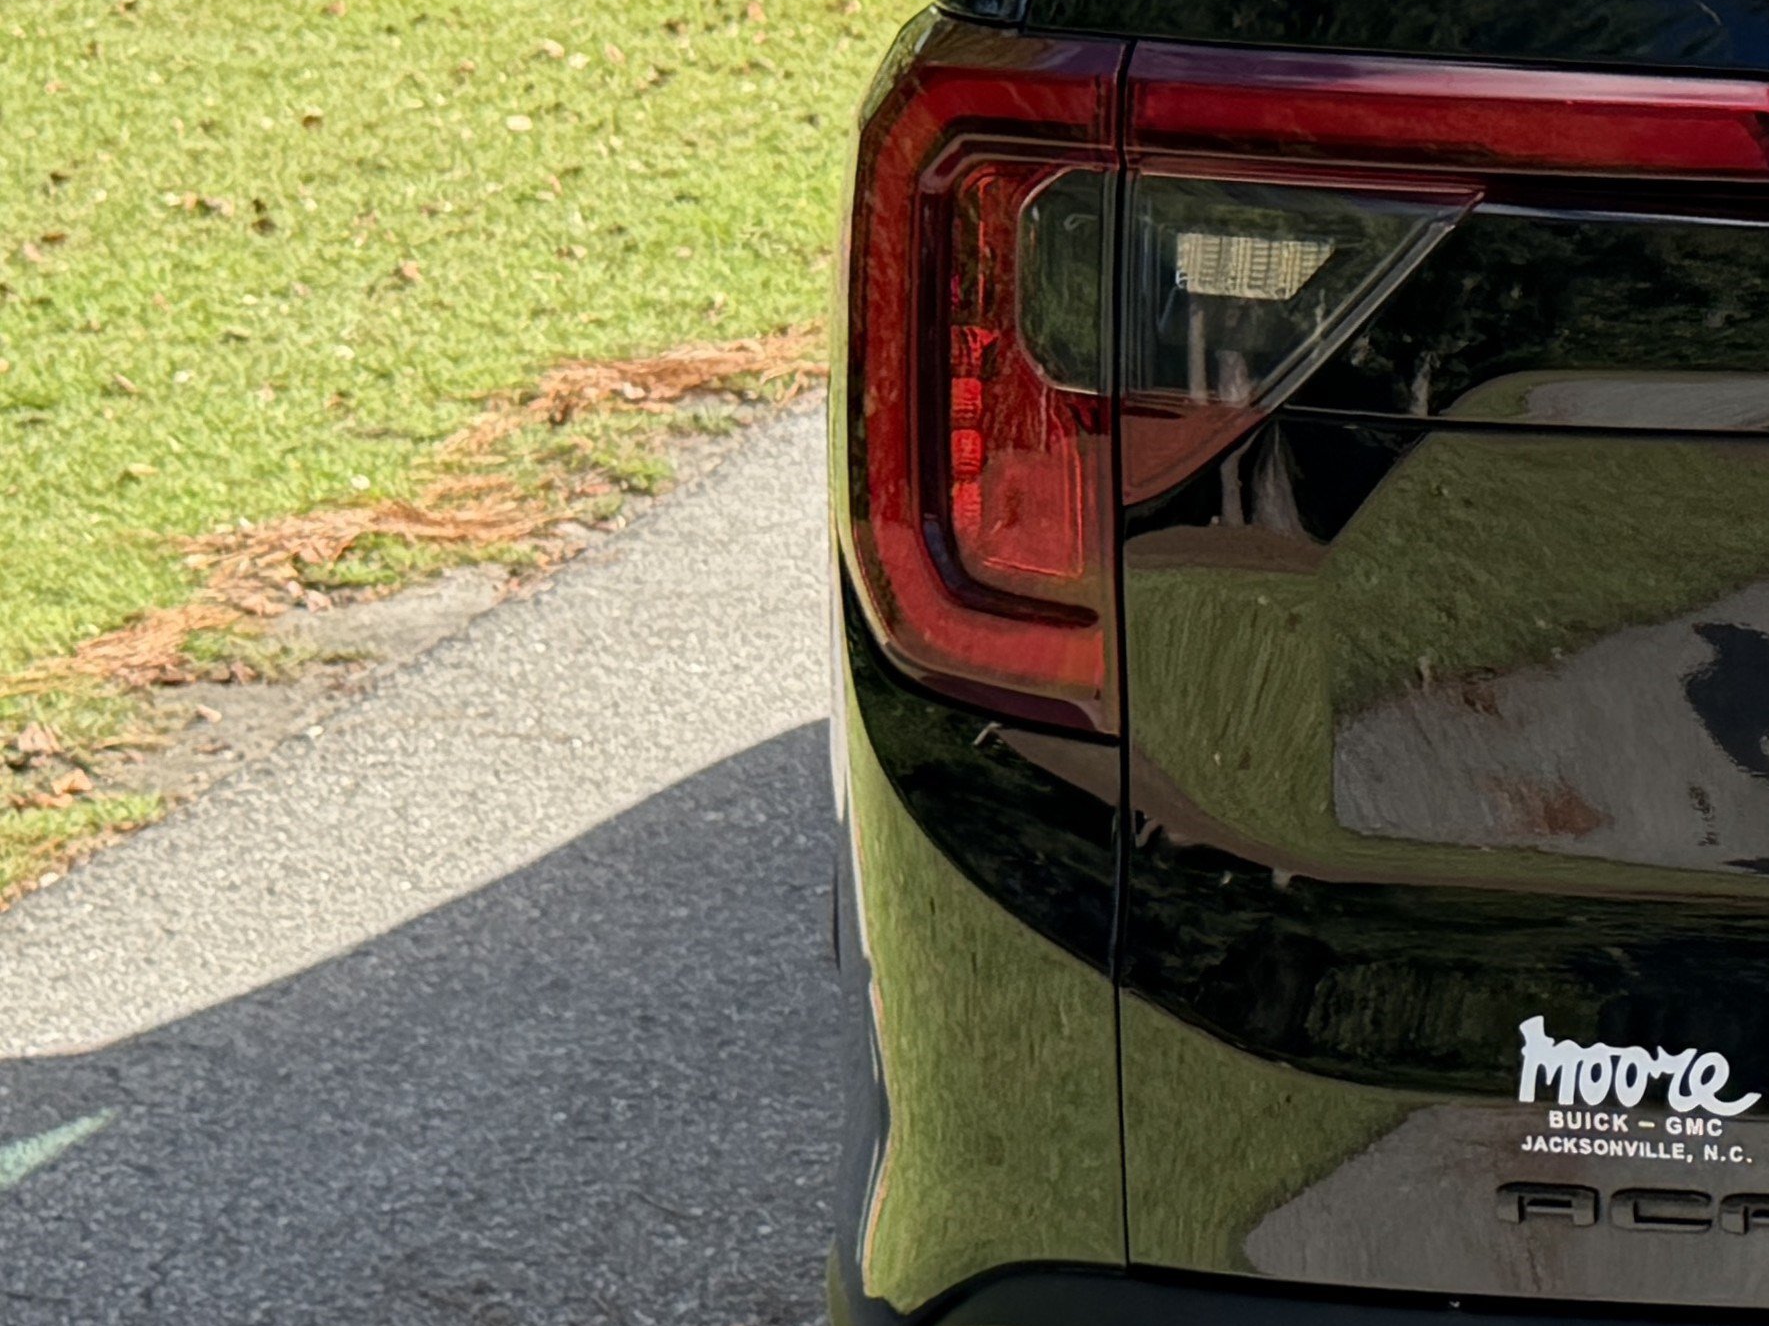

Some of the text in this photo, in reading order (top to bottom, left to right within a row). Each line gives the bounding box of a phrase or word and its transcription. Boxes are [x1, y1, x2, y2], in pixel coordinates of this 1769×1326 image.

[1549, 1110, 1629, 1133] BUICK
[1665, 1116, 1723, 1137] GMC
[1521, 1135, 1753, 1163] JACKSONVILLE, N.C.
